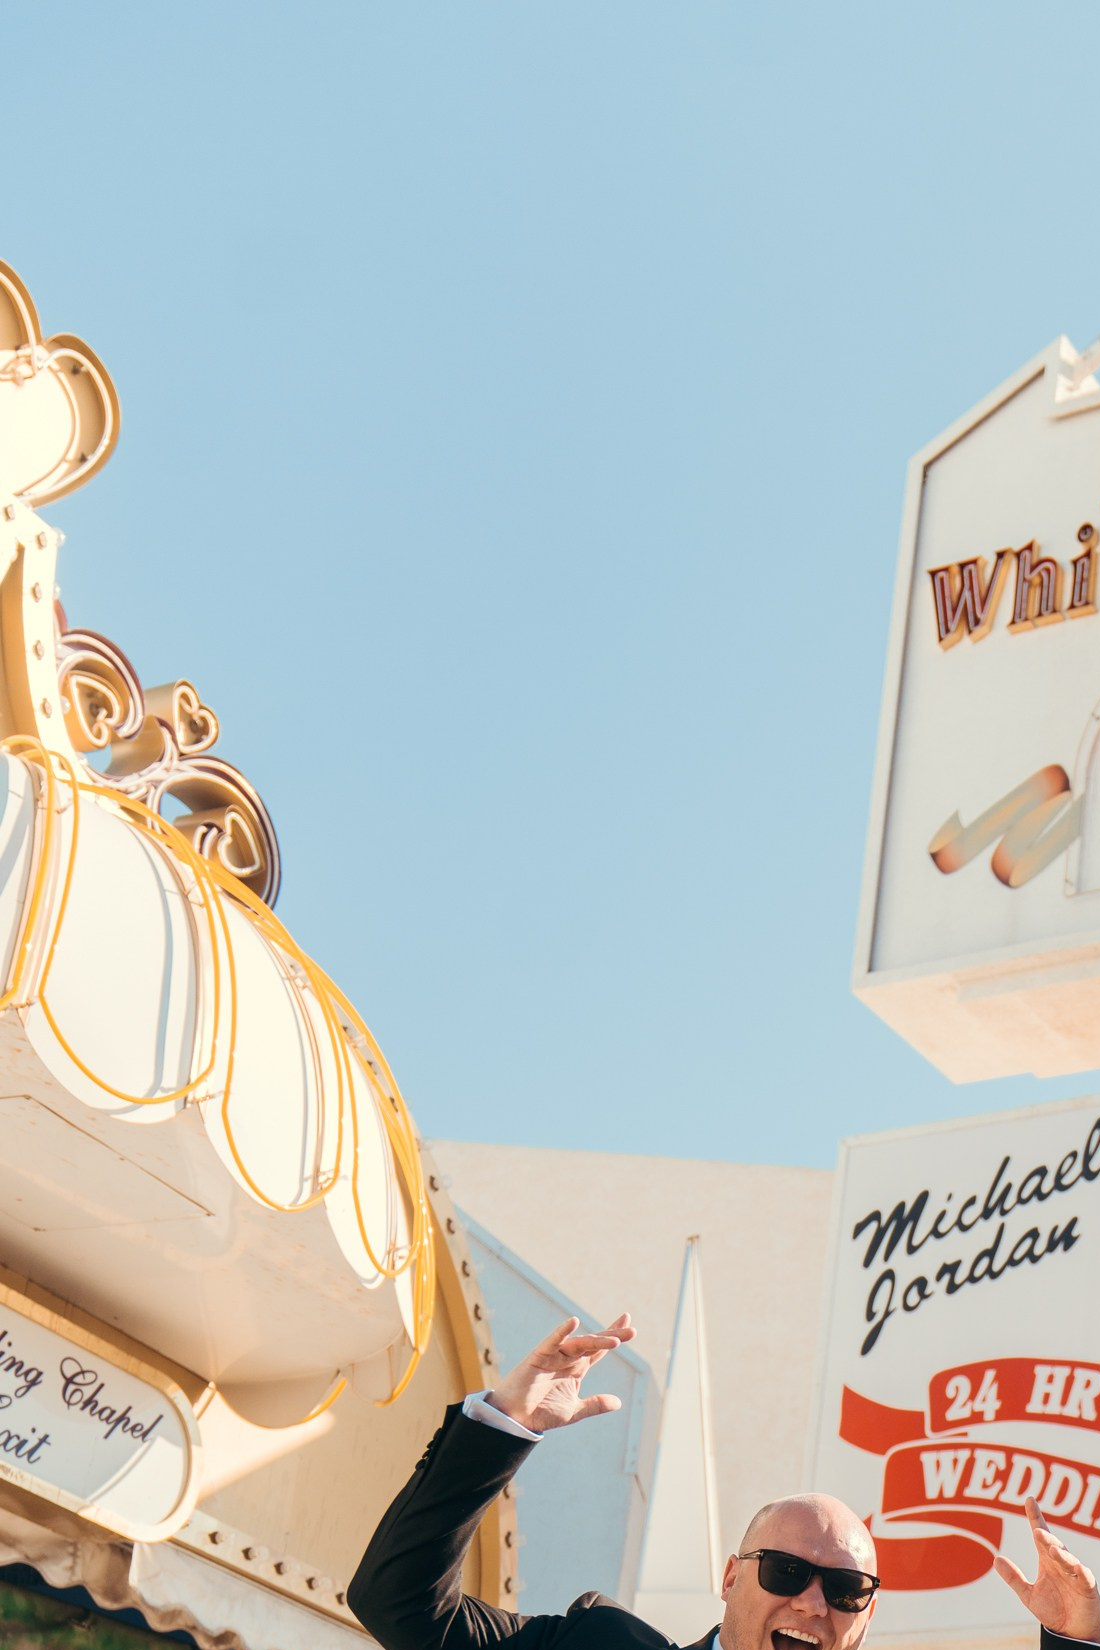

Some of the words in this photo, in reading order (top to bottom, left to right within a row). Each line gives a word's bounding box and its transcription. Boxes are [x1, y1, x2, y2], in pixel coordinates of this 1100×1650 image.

[860, 1216, 1081, 1357] Jordan
[0, 1331, 43, 1398] ing
[60, 1357, 164, 1443] Chapel
[945, 1368, 1002, 1422] 24
